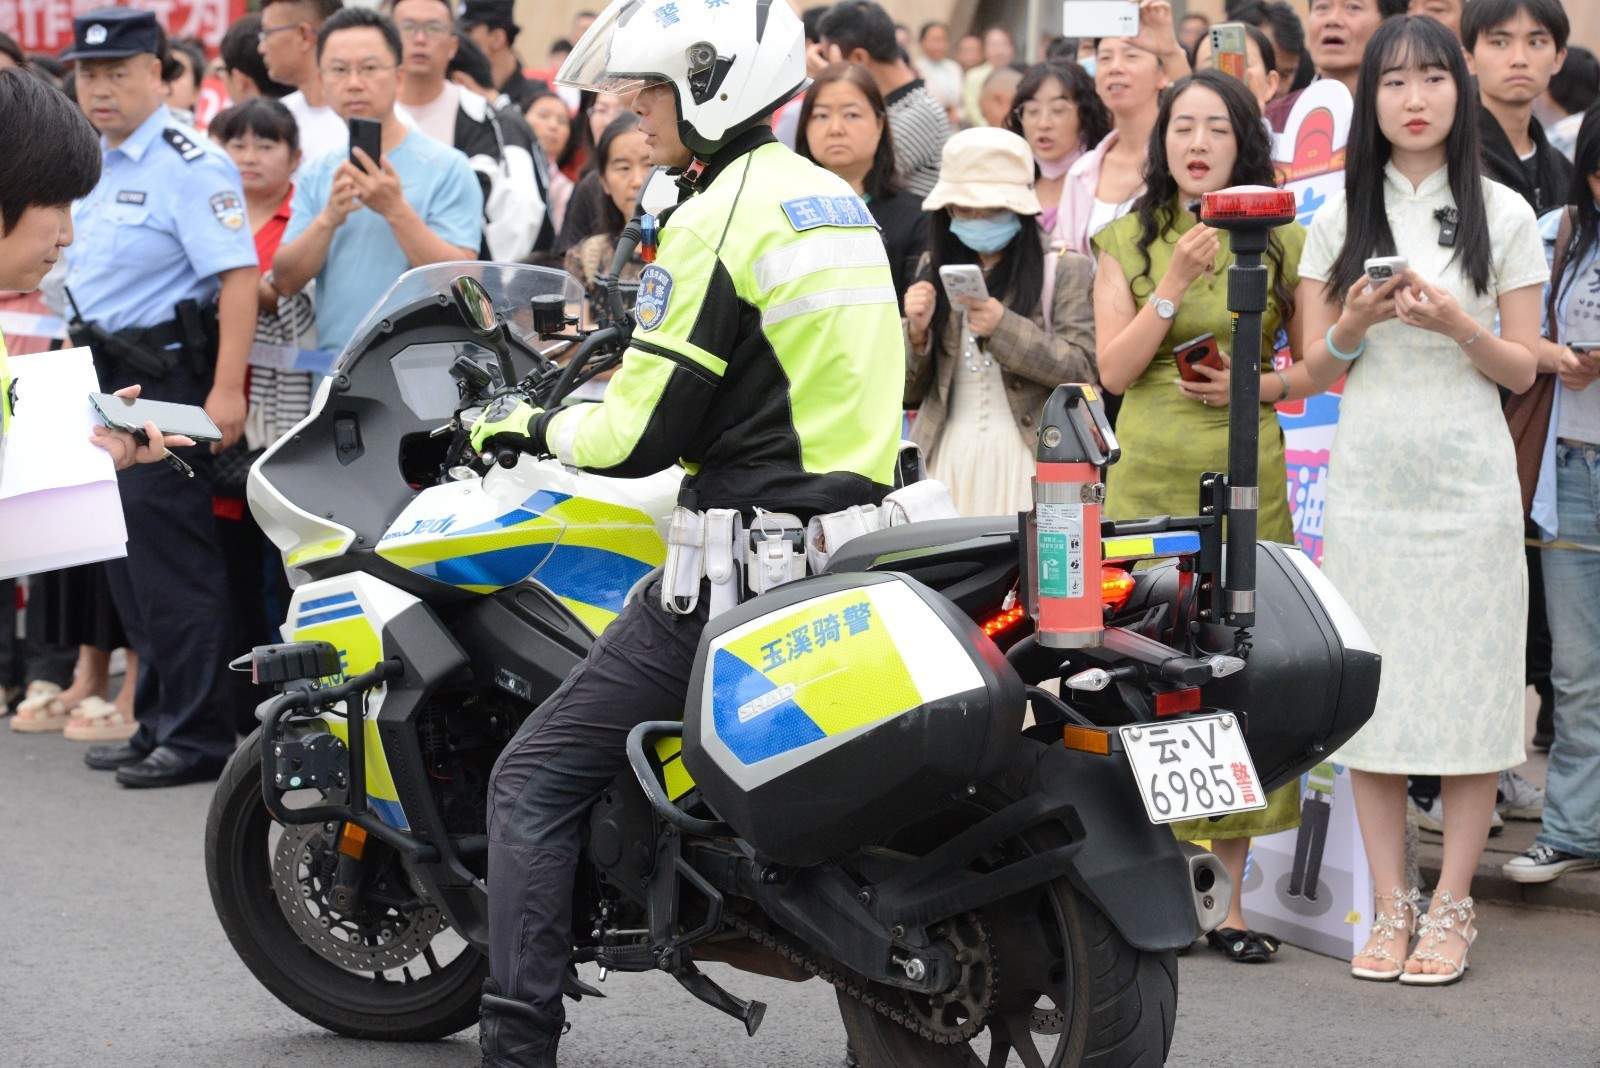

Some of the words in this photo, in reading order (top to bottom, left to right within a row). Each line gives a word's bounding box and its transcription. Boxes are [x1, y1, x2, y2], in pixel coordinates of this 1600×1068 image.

[760, 602, 871, 673] 玉溪骑警
[1151, 765, 1235, 815] 6985
[1231, 762, 1257, 804] 警
